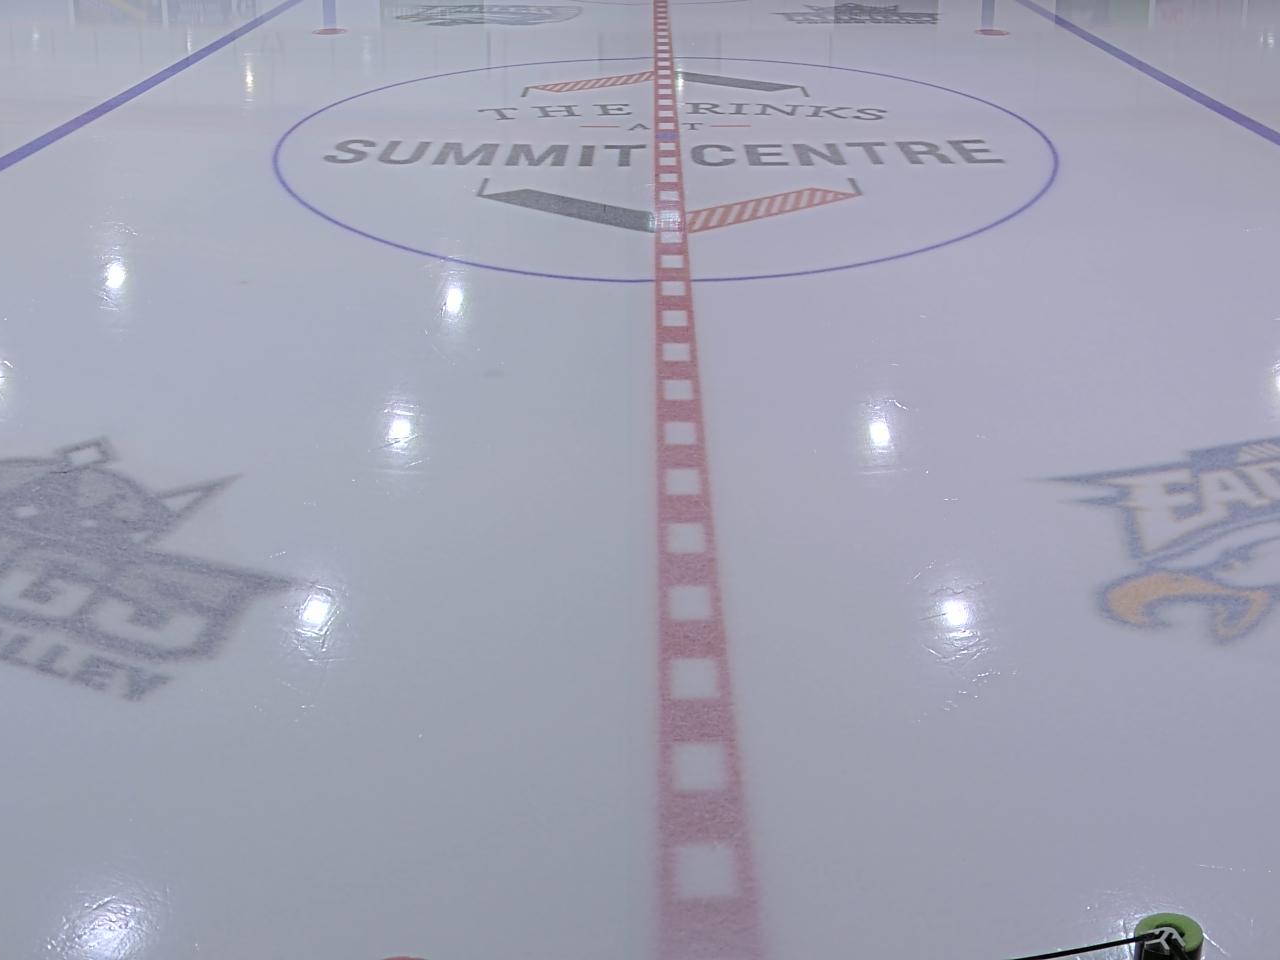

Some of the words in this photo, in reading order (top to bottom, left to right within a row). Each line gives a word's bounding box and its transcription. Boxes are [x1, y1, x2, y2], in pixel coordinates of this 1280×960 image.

[477, 103, 633, 121] THE
[685, 101, 889, 121] RINKS
[322, 139, 648, 168] SUMMIT
[689, 139, 1008, 168] CENTRE
